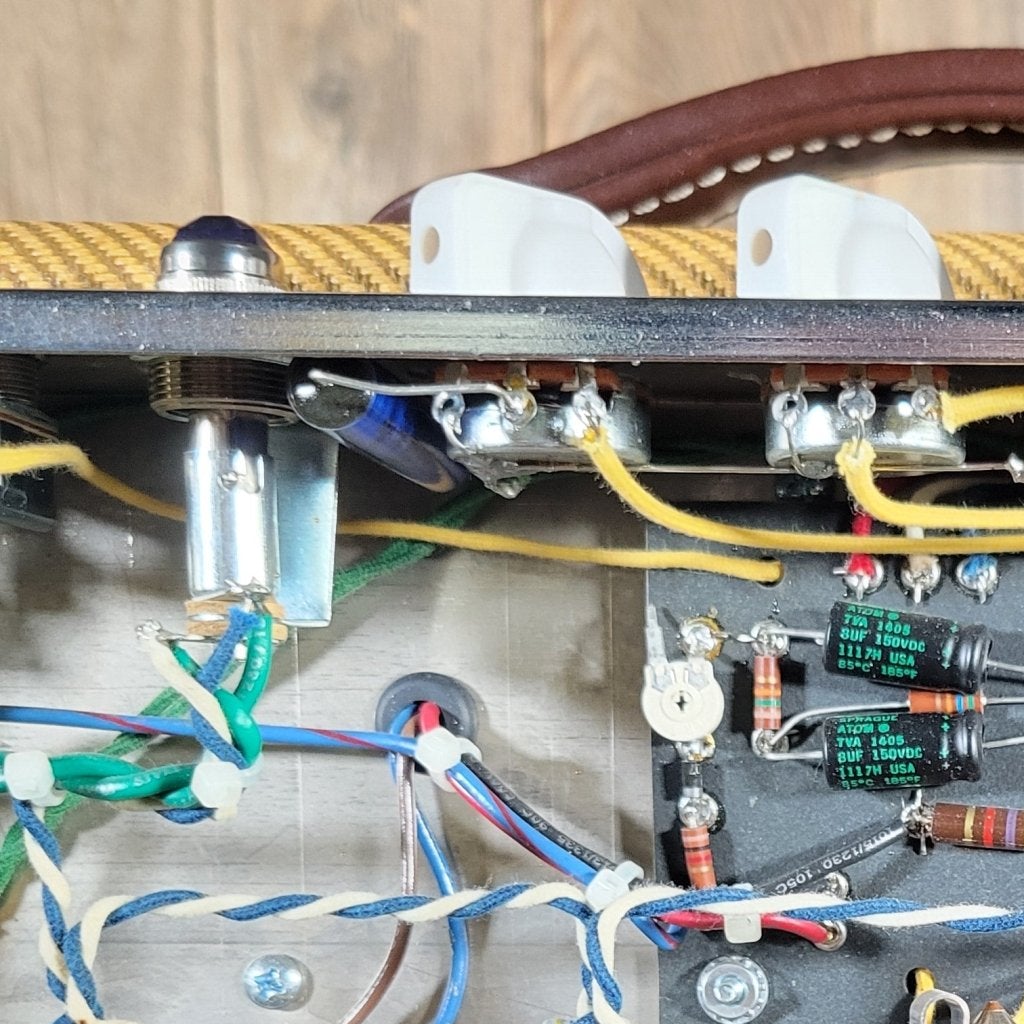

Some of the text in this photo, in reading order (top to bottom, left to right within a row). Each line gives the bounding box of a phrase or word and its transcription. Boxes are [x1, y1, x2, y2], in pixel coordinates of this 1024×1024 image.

[844, 614, 911, 636] TVA 1405
[840, 628, 926, 652] 8UF 150VDC
[838, 644, 915, 666] 1117H USA
[837, 724, 873, 734] ATOM
[837, 735, 904, 747] TVA 1405
[837, 747, 923, 763] 8UF 150VDC
[839, 764, 915, 780] 1117H USA
